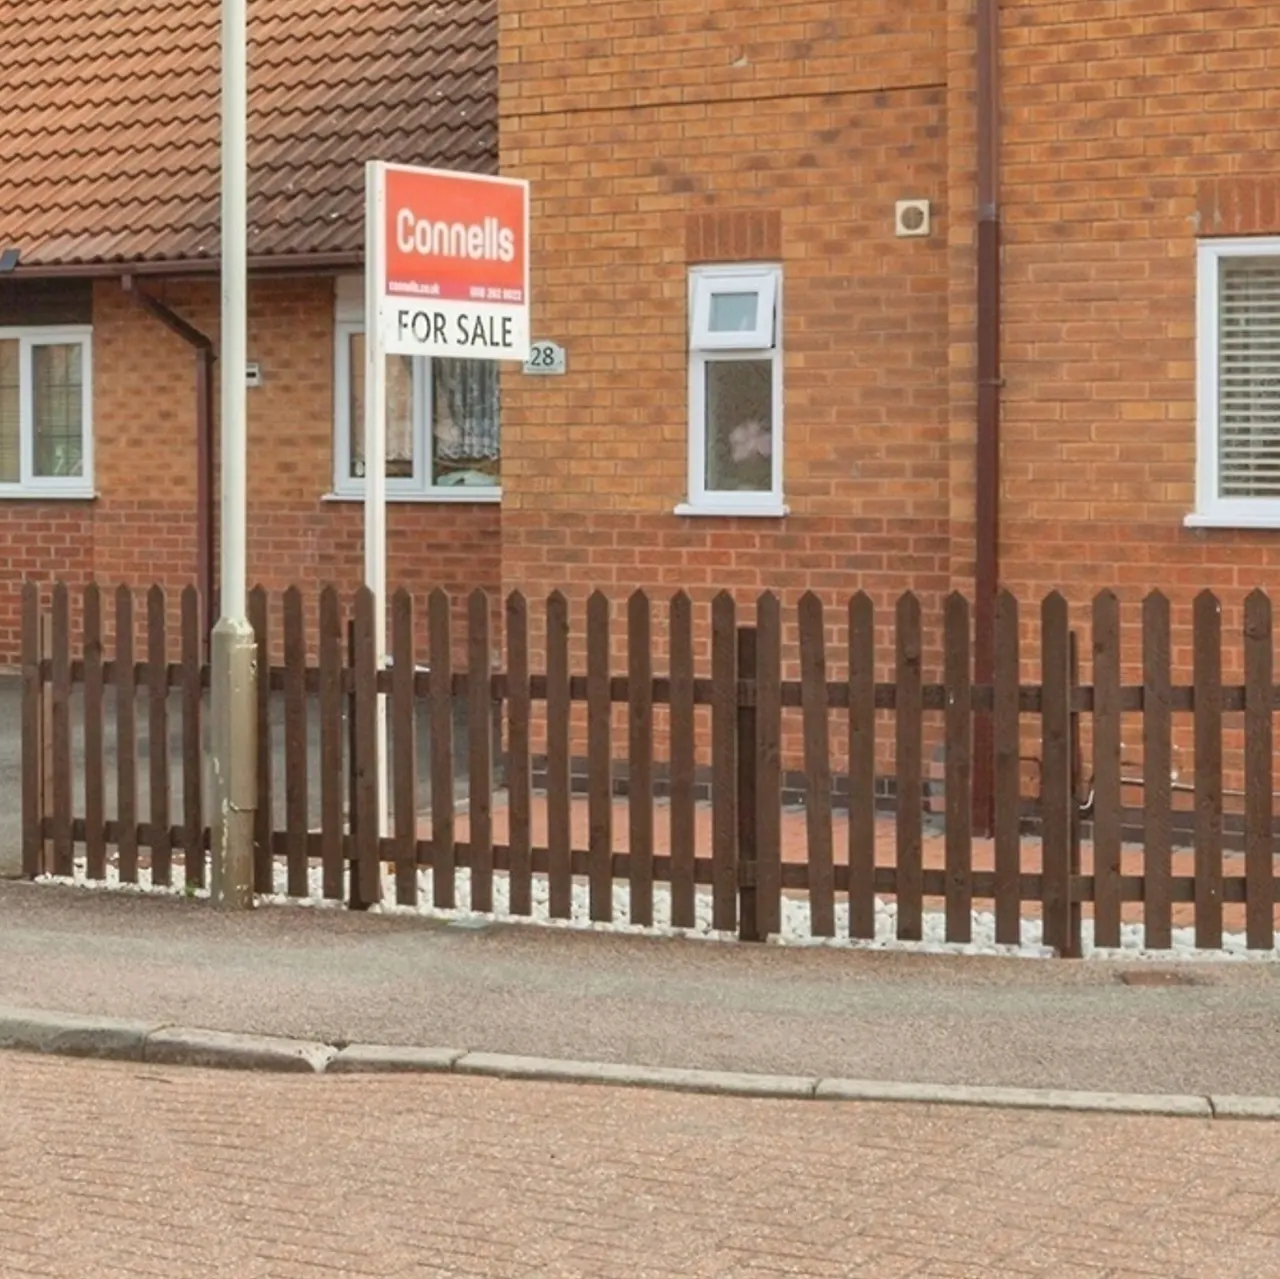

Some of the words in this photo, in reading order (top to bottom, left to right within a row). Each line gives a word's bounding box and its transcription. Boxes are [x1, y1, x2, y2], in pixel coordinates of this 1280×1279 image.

[396, 207, 515, 263] Connells
[397, 309, 448, 345] FOR
[456, 313, 514, 348] SALE
[531, 346, 555, 367] 28
